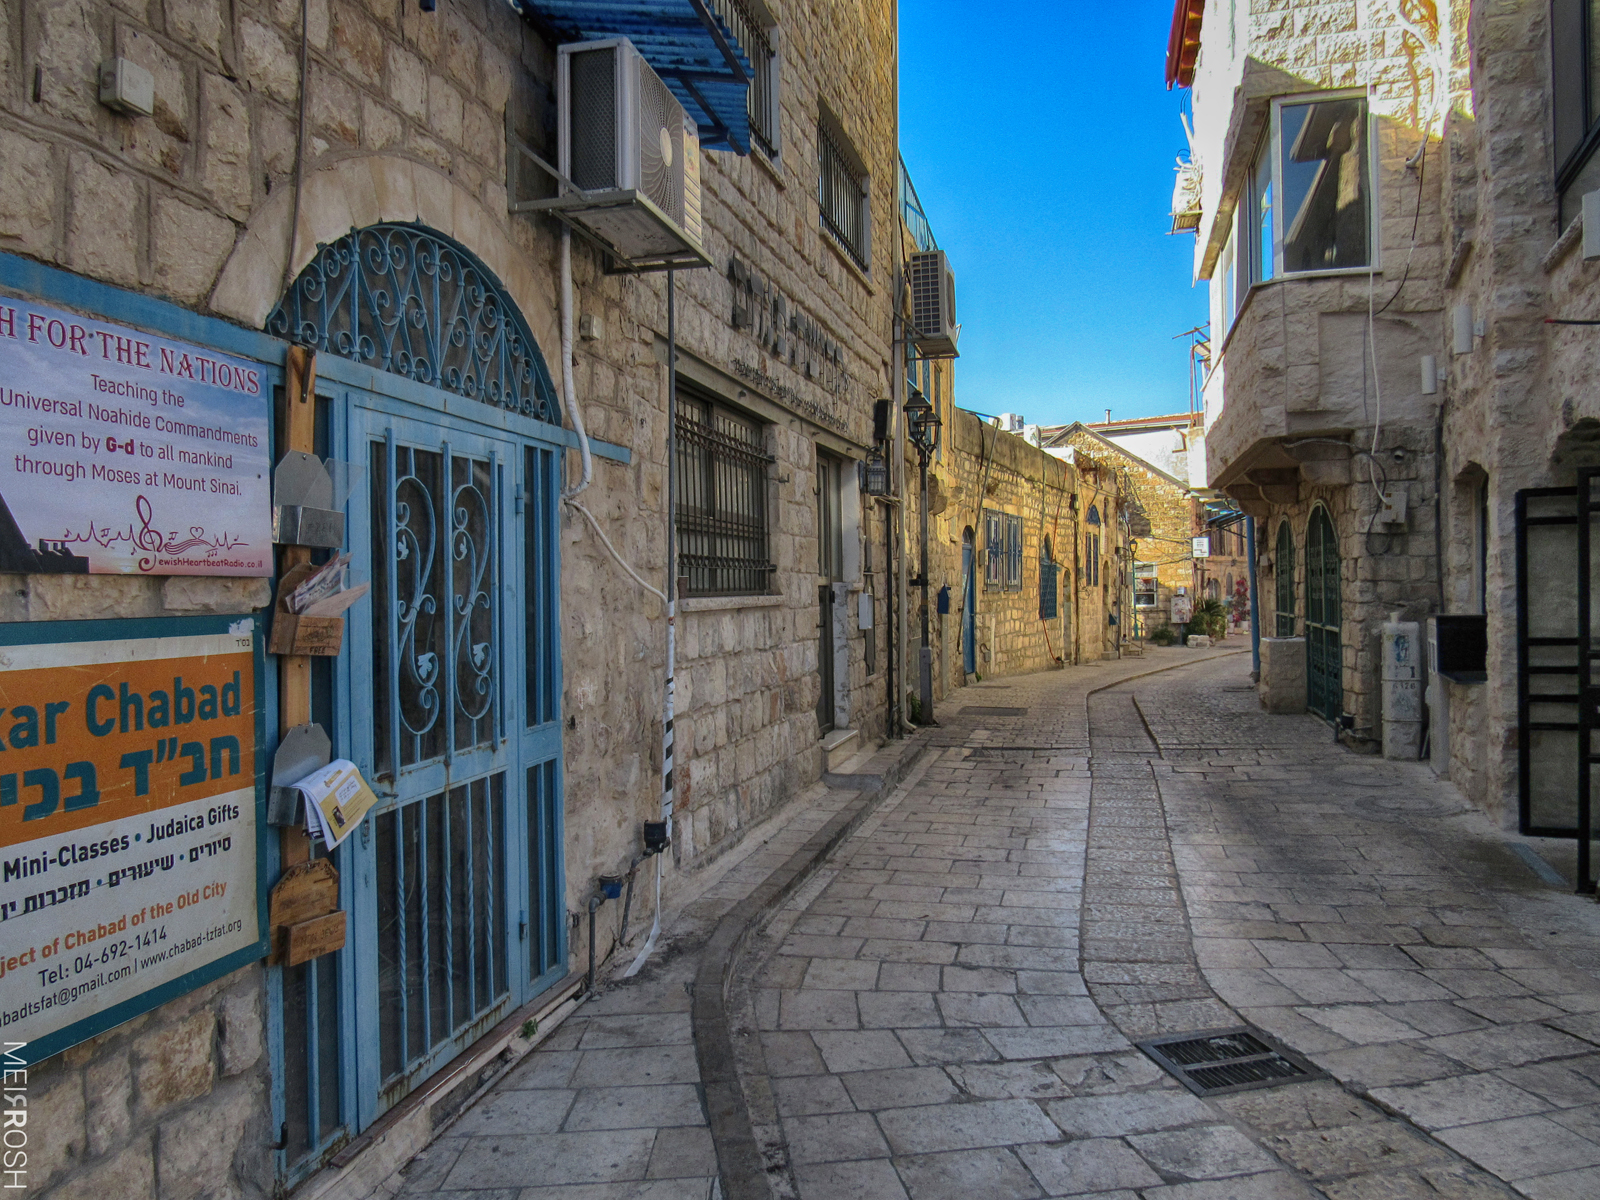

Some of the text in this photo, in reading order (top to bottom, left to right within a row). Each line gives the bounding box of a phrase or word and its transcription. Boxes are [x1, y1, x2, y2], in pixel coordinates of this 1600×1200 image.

[27, 313, 90, 356] FOR
[96, 331, 152, 369] THE
[160, 347, 260, 395] NATIONS
[0, 387, 258, 448] Universal Noahide Commandments
[91, 374, 185, 407] Teaching the
[15, 455, 243, 496] through Moses at Mount Sinai.
[27, 426, 233, 469] given by G-d to all mankind
[86, 670, 241, 737] Chabad
[4, 803, 239, 882] Mini-Classes Judaica Gifts
[109, 854, 175, 888] שיעורים
[189, 836, 231, 863] סיורים
[24, 879, 90, 914] מזכרות
[42, 937, 60, 958] of
[65, 915, 127, 950] Chabad
[131, 908, 147, 926] of
[150, 903, 174, 919] the
[177, 889, 199, 909] Old
[203, 880, 227, 899] City
[0, 965, 131, 1028] badtsfat@gmail.com
[140, 919, 242, 969] www.chabad-tzfat.org
[38, 925, 167, 987] Tel: 04-692-1414
